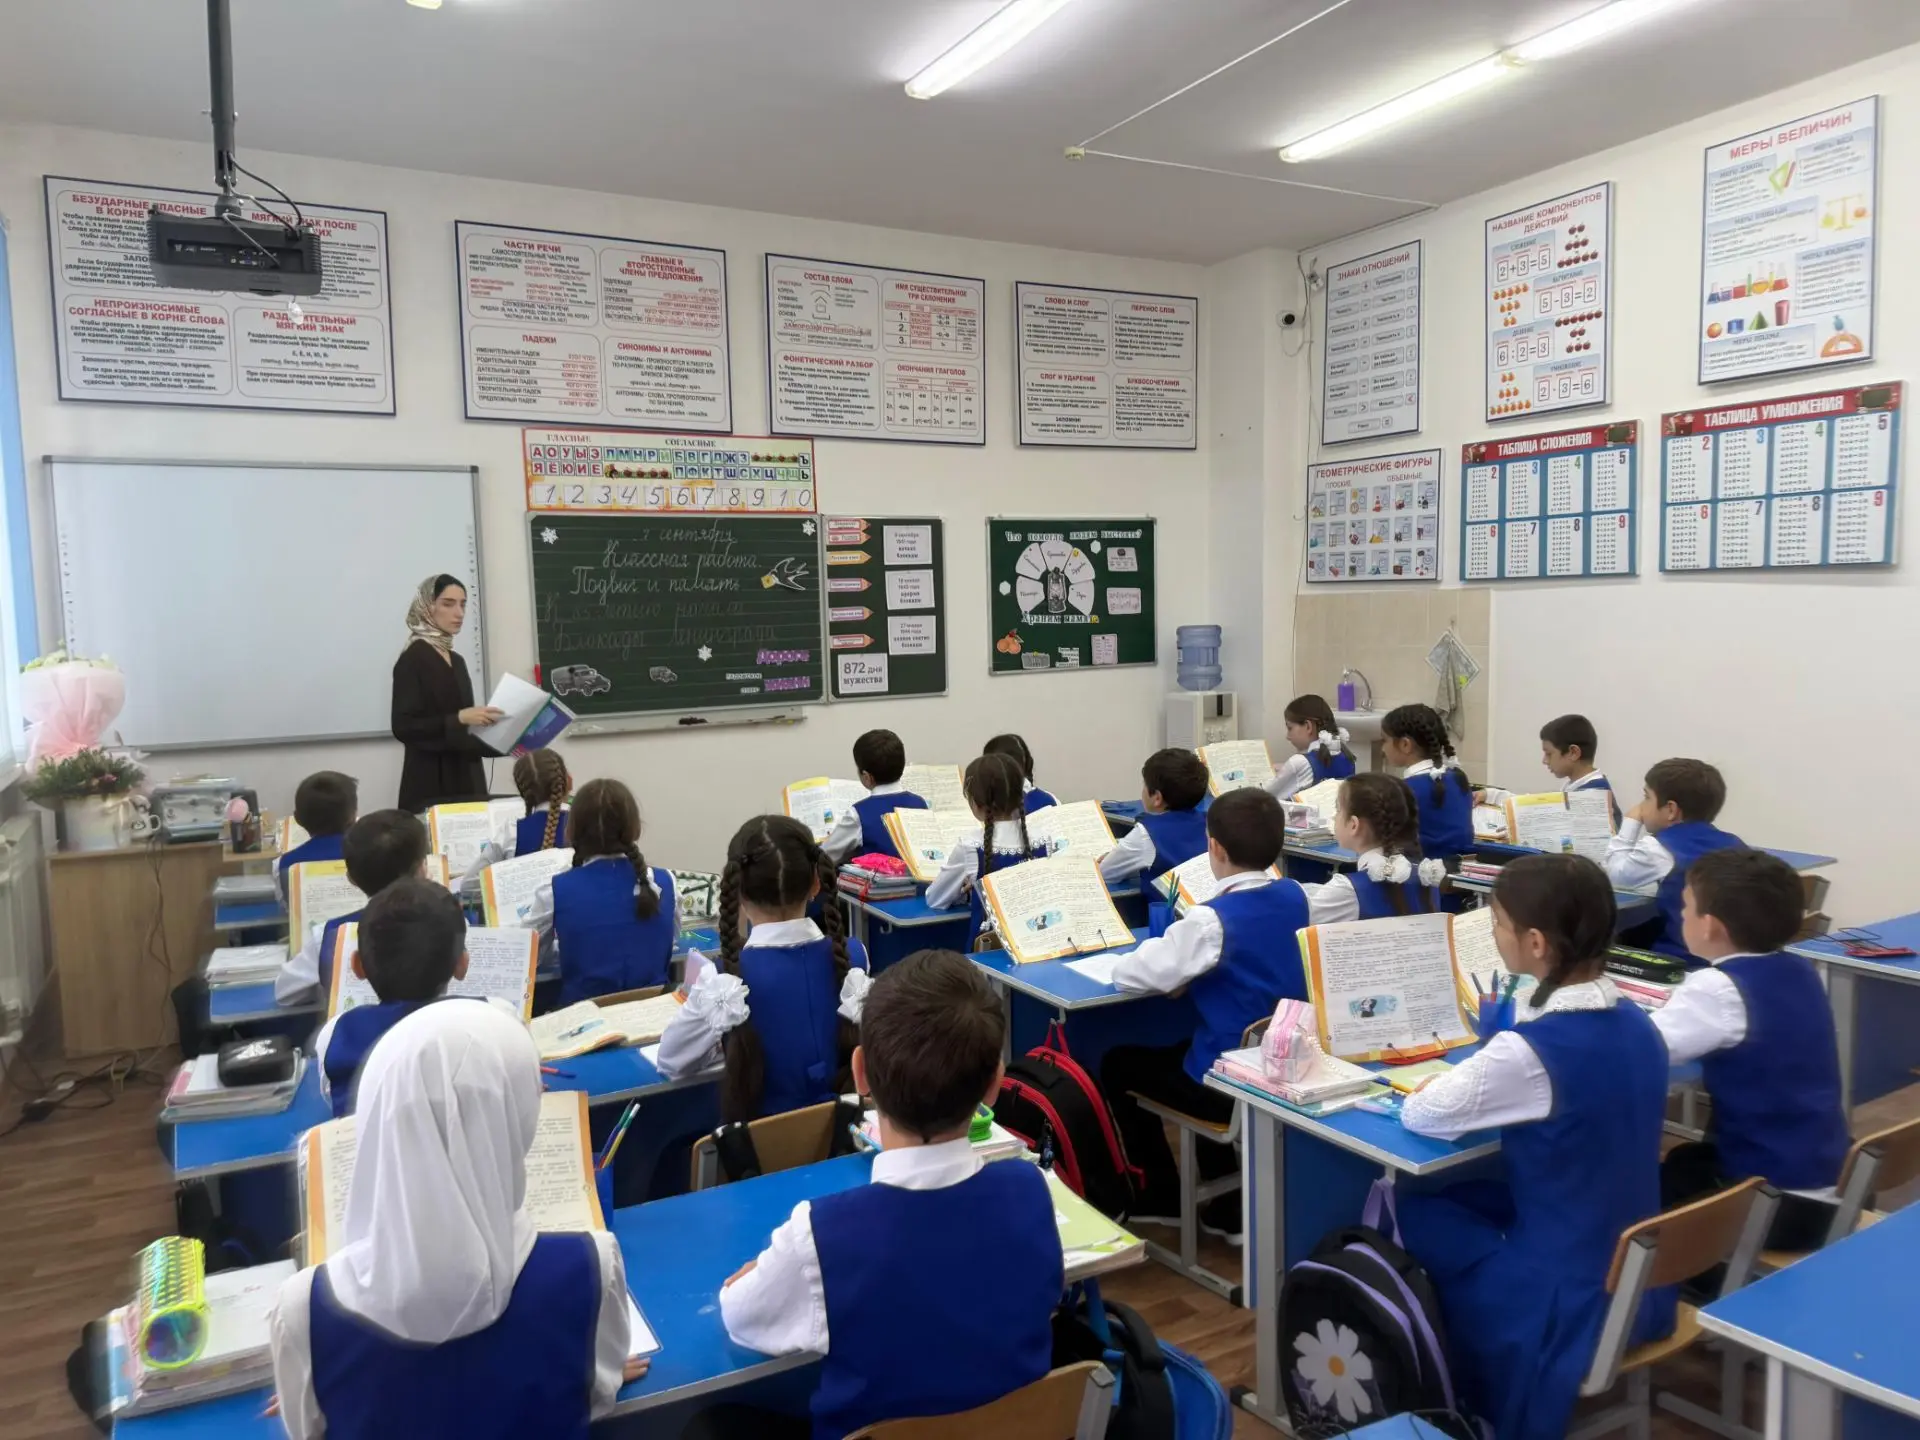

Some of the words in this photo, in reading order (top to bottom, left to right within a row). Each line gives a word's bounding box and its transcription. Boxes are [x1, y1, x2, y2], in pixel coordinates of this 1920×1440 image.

[1730, 136, 1772, 159] МЕРЫ
[1778, 112, 1853, 145] ВЕЛИЧИН
[72, 194, 150, 210] БЕЗУДАРНЫЕ
[106, 208, 144, 218] КОРНЕ
[1492, 213, 1534, 232] НАЗВАНИЕ
[1536, 192, 1602, 220] КОМПОНЕНТОВ
[324, 220, 358, 231] ПОСЛЕ
[1524, 213, 1569, 234] ДЕЙСТВИЙ
[504, 240, 536, 250] ЧАСТИ
[537, 243, 562, 252] РЕЧИ
[626, 261, 696, 274] ВТОРОСТЕПЕННЫЕ
[641, 255, 676, 266] ГЛАВНЫЕ
[1337, 266, 1360, 282] ЗНАКИ
[1362, 252, 1410, 275] ОТНОШЕНИЙ
[620, 268, 646, 278] ЧЛЕНЫ
[648, 270, 704, 282] ПРЕДЛОЖЕНИЯ
[804, 272, 830, 282] СОСТАВ
[832, 276, 853, 284] СЛОВА
[910, 284, 967, 297] СУЩЕСТВИТЕЛЬНОЕ
[908, 292, 920, 300] ТРИ
[921, 294, 956, 304] СКЛОНЕНИЯ
[94, 299, 200, 314] НЕПРОИЗНОСИМЫЕ
[68, 307, 140, 320] СОГЛАСНЫЕ
[142, 312, 148, 320] В
[152, 313, 186, 322] КОРНЕ
[189, 316, 225, 324] СЛОВА
[262, 311, 356, 324] РАЗДИТЕЛЬНЫЙ
[276, 321, 316, 331] МЯГКИЙ
[320, 325, 344, 333] ЗНАК
[522, 335, 556, 344] ПАДЕЖИ
[618, 342, 662, 352] СИНОНИМЫ
[663, 346, 670, 354] И
[670, 347, 712, 357] АНТОНИМЫ
[784, 356, 844, 366] ФОНЕТИЧЕСКИЙ
[846, 360, 874, 368] РАЗБОР
[898, 364, 934, 373] ОКОНЧАНИЯ
[936, 368, 966, 376] ГЛАГОЛОВ
[1704, 408, 1758, 427] ТАБЛИЦА
[1762, 395, 1844, 420] УМНОЖЕНИЯ
[1702, 436, 1710, 450] 2
[1756, 429, 1764, 444] 3
[1815, 422, 1824, 438] 4
[1878, 414, 1887, 430] 5
[546, 434, 592, 443] ГЛАСНЫЕ
[665, 439, 716, 448] СОГЛАСНЫЕ
[1498, 439, 1538, 456] ТАБЛИЦА
[1540, 432, 1592, 450] СЛОЖЕНИЯ
[1316, 461, 1392, 478] ГЕОМЕТРИЧЕСКИЕ
[1394, 457, 1433, 469] ФИГУРЫ
[1491, 466, 1497, 480] 2
[1532, 462, 1538, 475] 3
[1574, 456, 1581, 470] 4
[1620, 450, 1626, 464] 5
[1324, 480, 1352, 489] ПЛОСКИЕ
[546, 485, 556, 504] 1
[572, 484, 584, 504] 2
[598, 486, 612, 504] 3
[622, 486, 638, 504] 4
[648, 486, 664, 506] 5
[676, 488, 690, 506] 6
[702, 488, 716, 506] 7
[729, 488, 740, 506] 8
[752, 488, 765, 506] 9
[1700, 504, 1708, 519] 6
[1755, 500, 1762, 516] 7
[1812, 496, 1820, 512] 8
[1874, 490, 1883, 506] 9
[1490, 526, 1496, 538] 6
[1530, 522, 1536, 535] 7
[1574, 518, 1580, 532] 8
[1618, 515, 1626, 528] 9
[602, 538, 688, 568] Классная
[570, 565, 638, 604] Подвиг
[669, 577, 741, 594] память
[844, 662, 866, 674] 872
[844, 676, 883, 688] мужества
